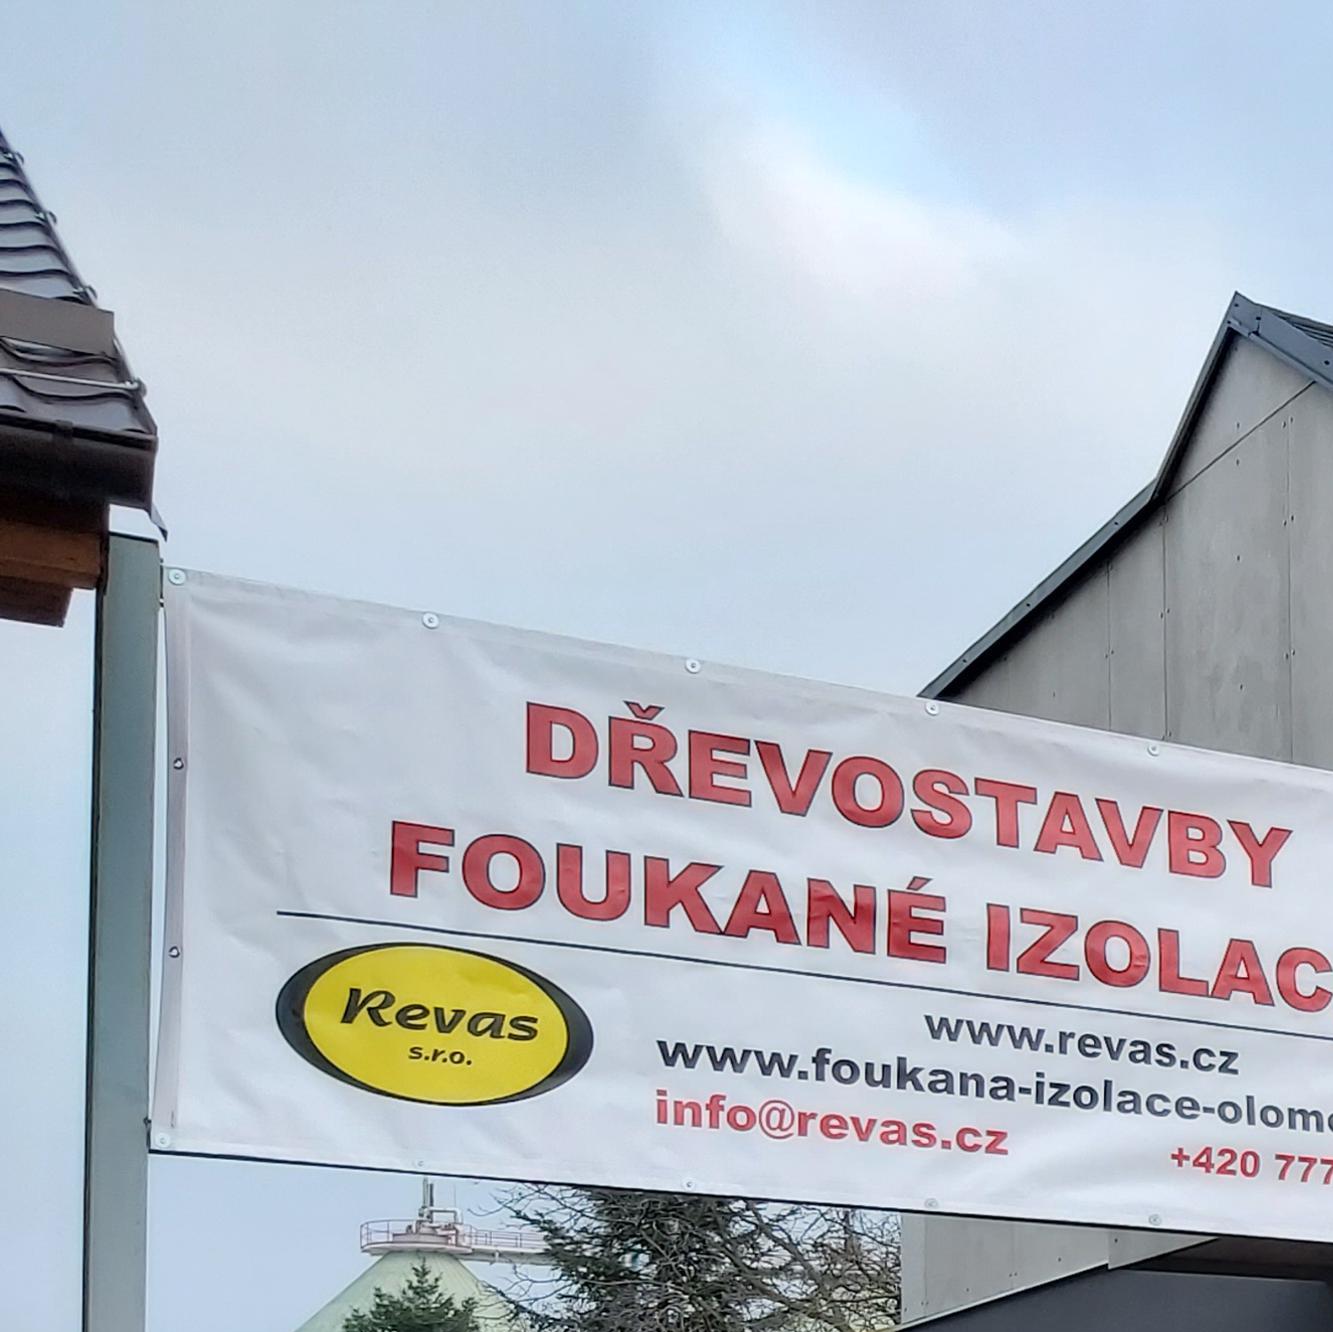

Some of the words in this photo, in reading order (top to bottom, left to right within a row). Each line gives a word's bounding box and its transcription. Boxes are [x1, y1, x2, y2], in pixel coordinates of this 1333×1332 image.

[525, 699, 1293, 888] DŘEVOSTAVBY
[389, 820, 947, 964] FOUKANÉ
[341, 987, 539, 1042] Revas
[924, 1013, 1240, 1076] www.revas.cz
[408, 1046, 473, 1067] s.r.o.
[656, 1090, 1009, 1156] info@revas.cz
[1170, 1146, 1260, 1180] +420
